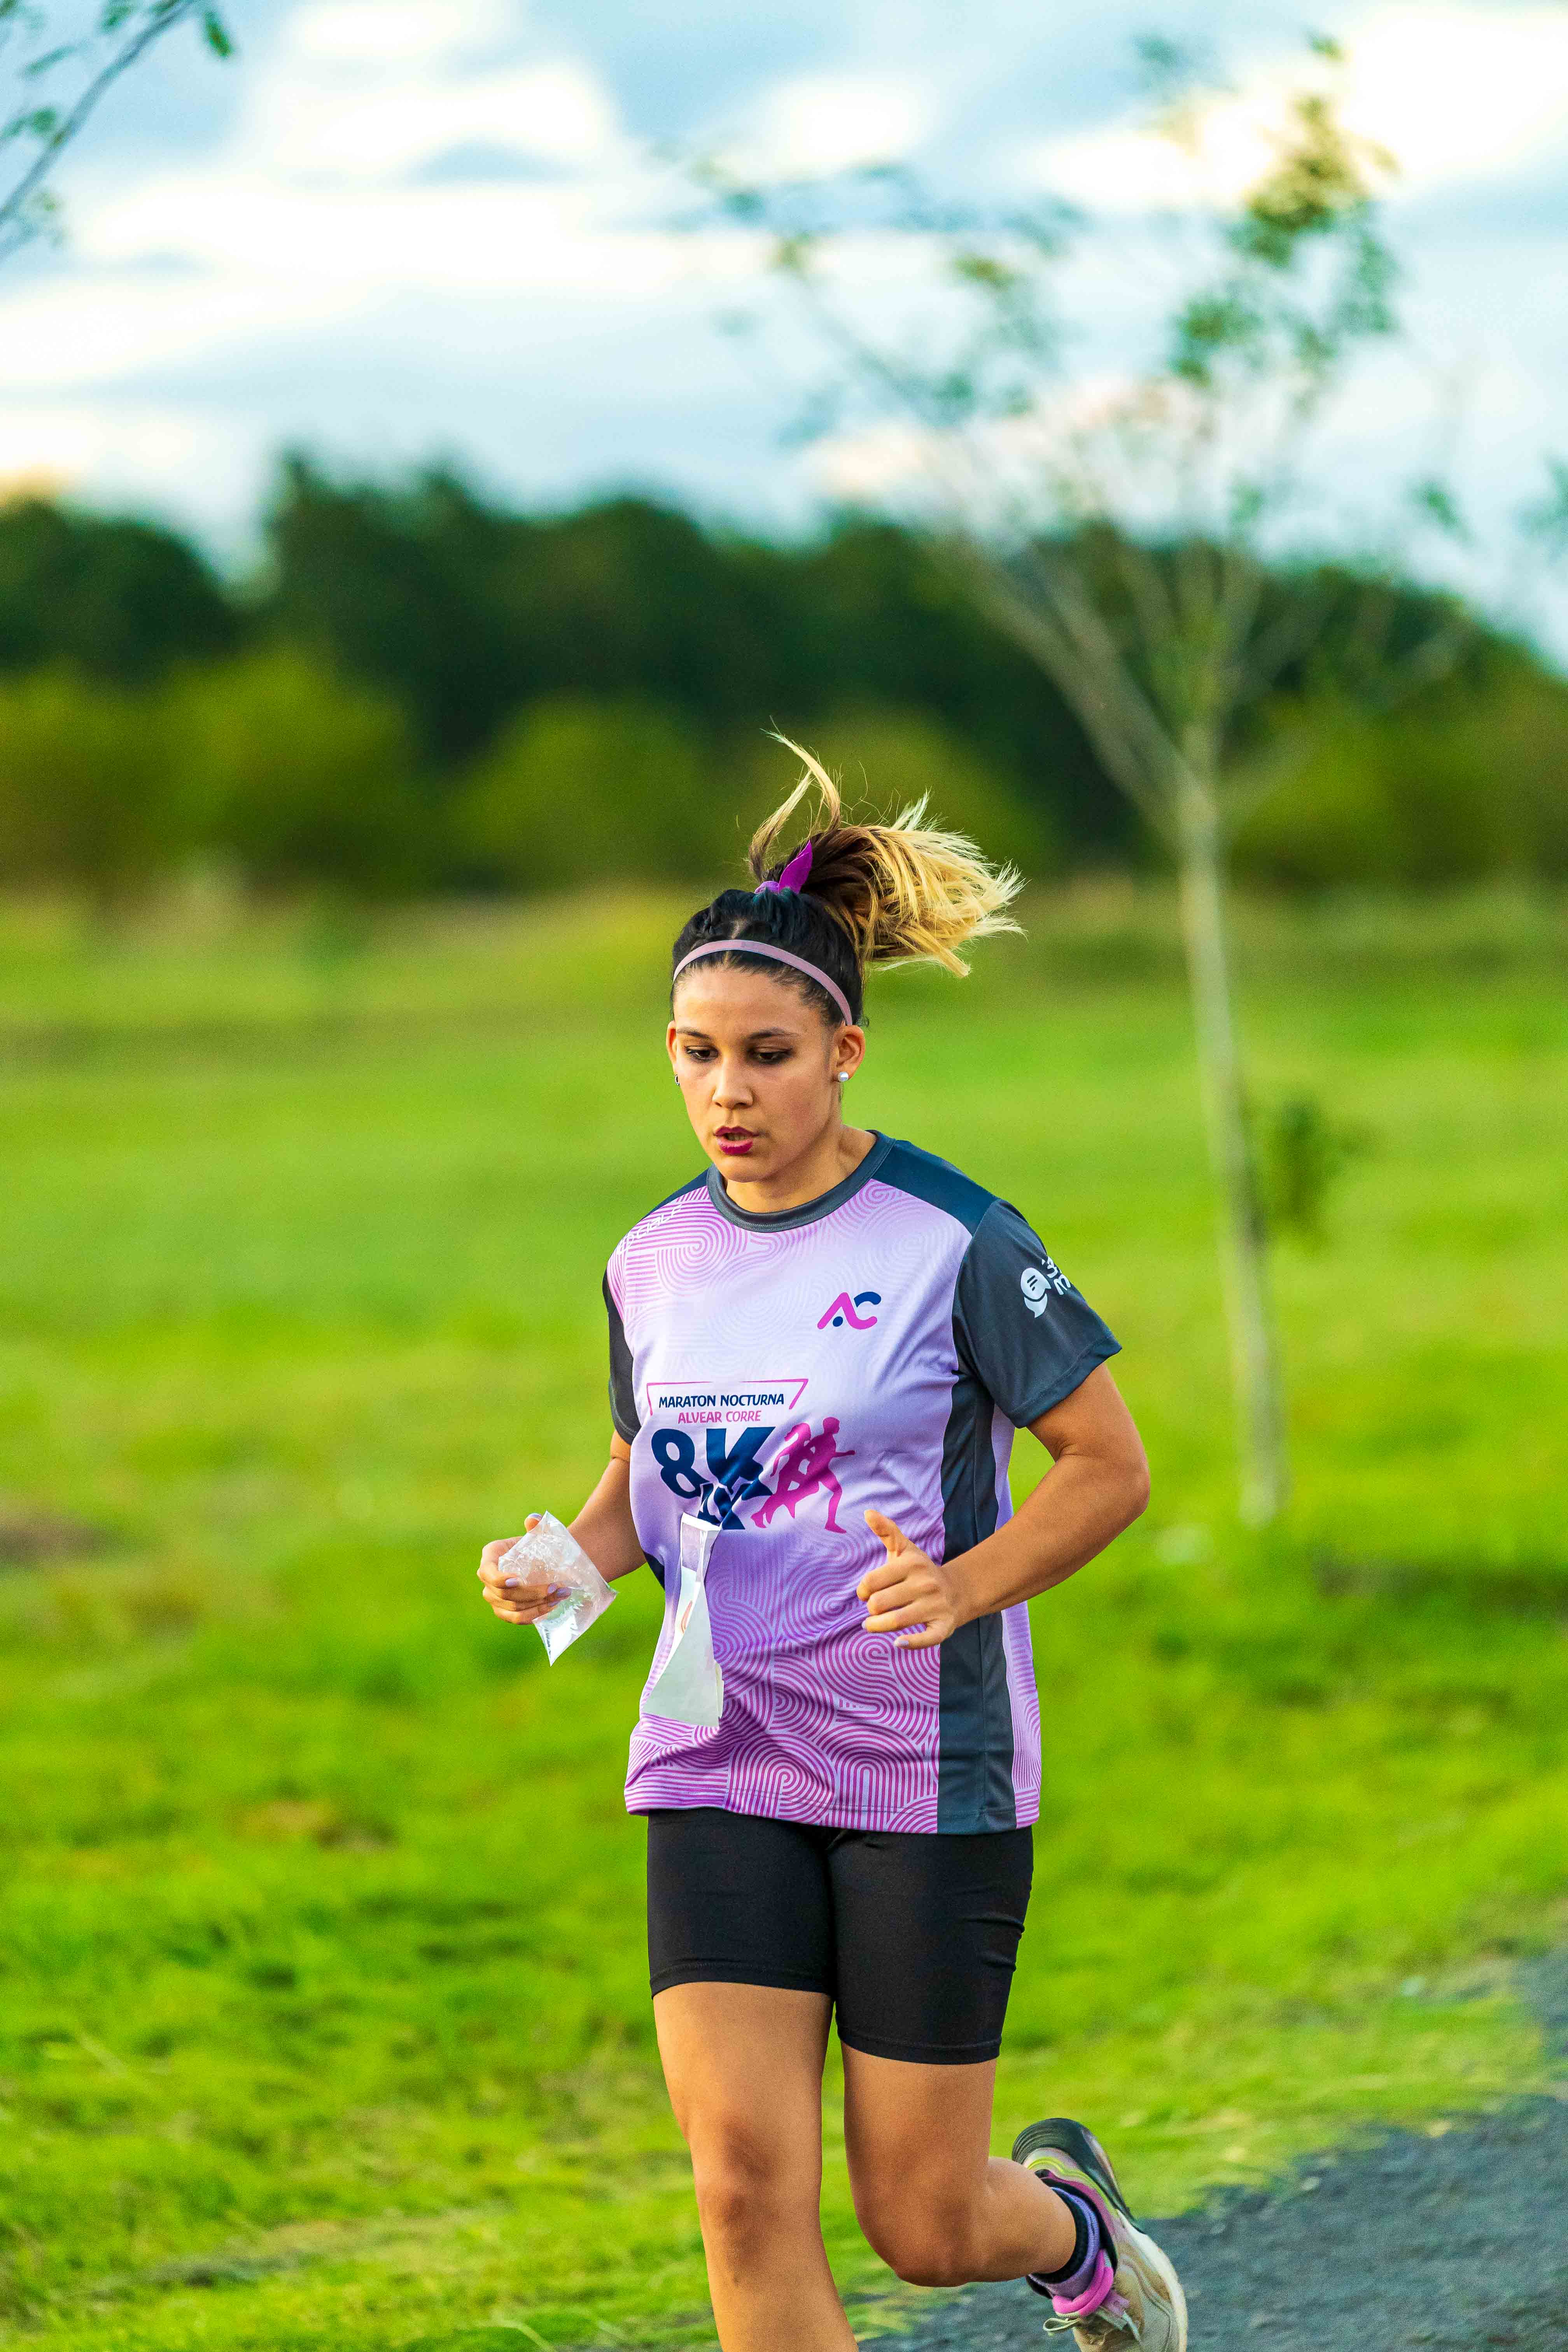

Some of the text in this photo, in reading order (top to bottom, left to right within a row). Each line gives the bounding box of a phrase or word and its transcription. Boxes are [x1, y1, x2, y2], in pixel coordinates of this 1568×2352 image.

[658, 1393, 784, 1408] MARATON NOCTURNA
[678, 1410, 762, 1424] ALVEAR CORRE
[651, 1426, 776, 1500] 8K
